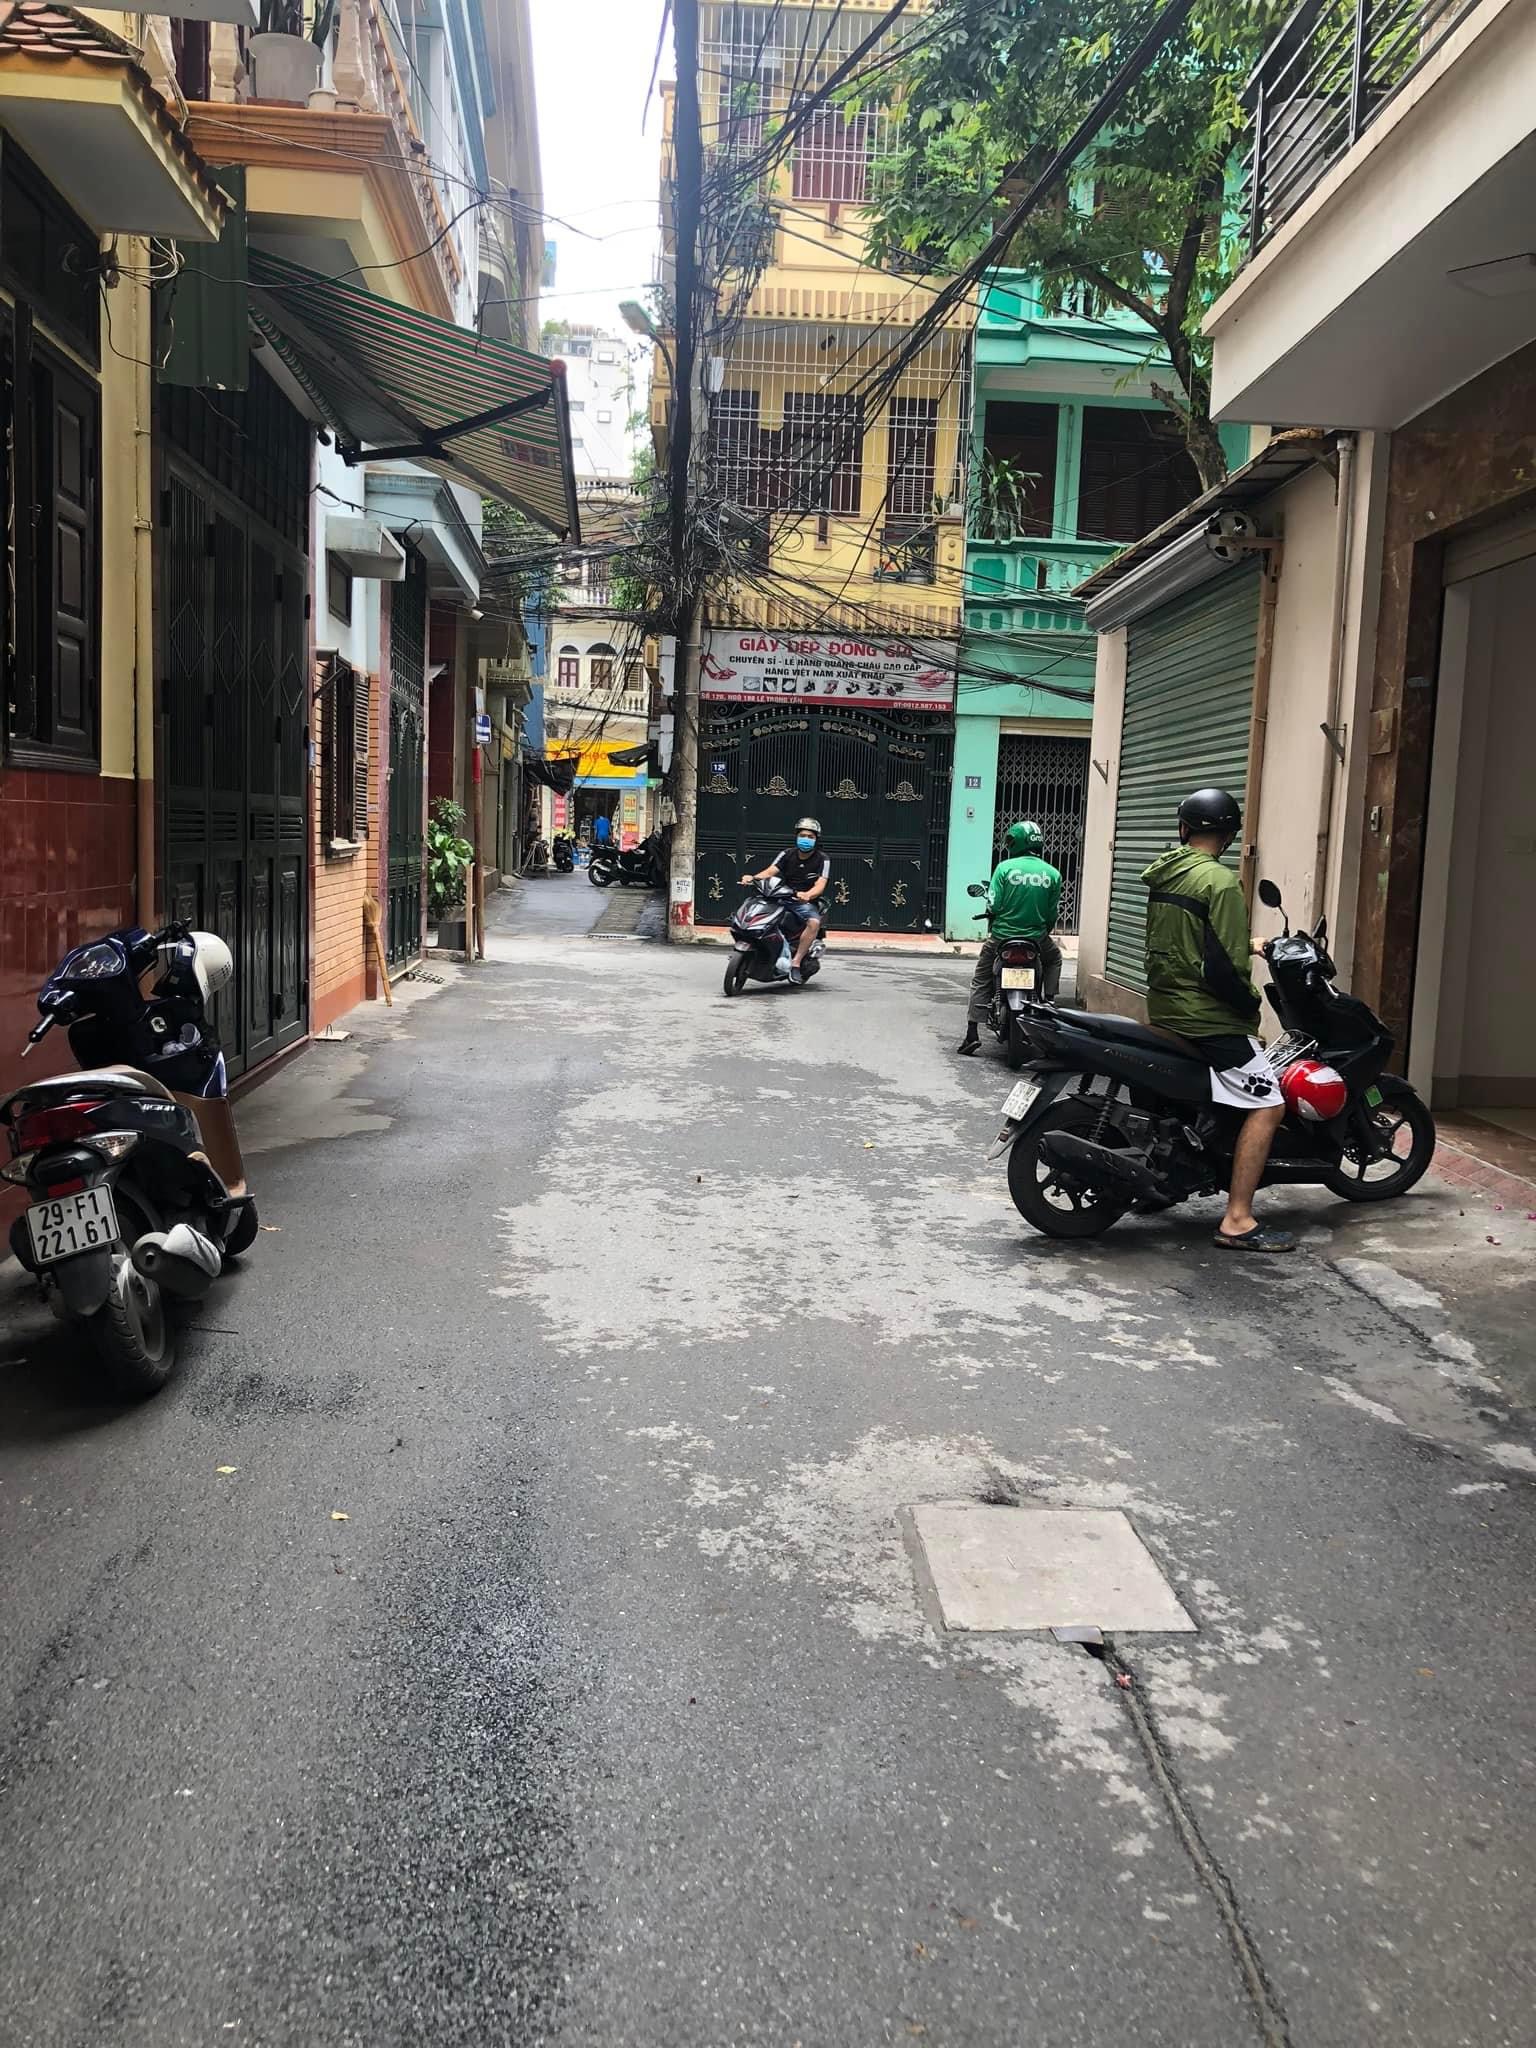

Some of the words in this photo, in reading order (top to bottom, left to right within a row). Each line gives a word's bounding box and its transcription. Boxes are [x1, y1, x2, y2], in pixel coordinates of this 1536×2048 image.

[729, 655, 765, 665] CHUYÊN
[813, 670, 833, 678] NAM
[1008, 869, 1051, 889] Grab
[38, 1191, 101, 1232] 29-F1
[37, 1215, 112, 1260] 221.61
